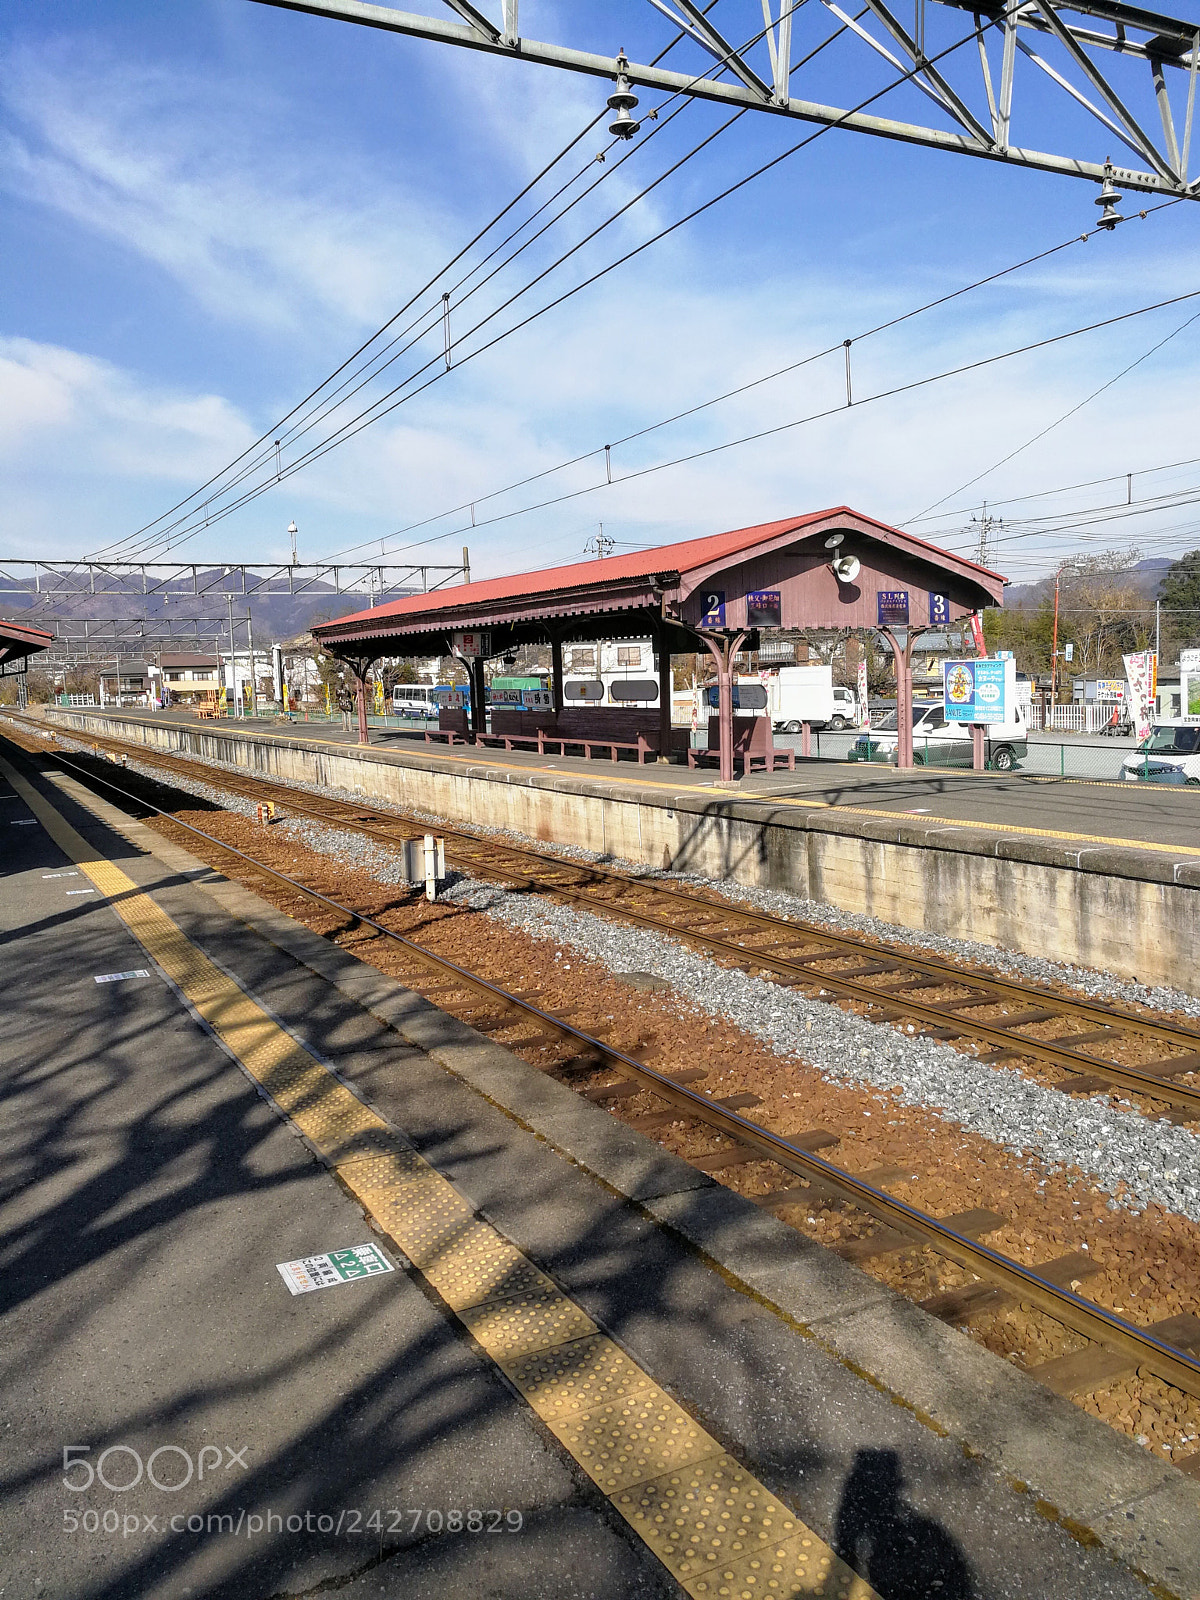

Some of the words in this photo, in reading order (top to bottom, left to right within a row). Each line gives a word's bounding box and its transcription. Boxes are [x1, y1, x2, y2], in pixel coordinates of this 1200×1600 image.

[707, 594, 720, 616] 2
[934, 594, 945, 614] 3
[289, 1263, 312, 1289] とまりません
